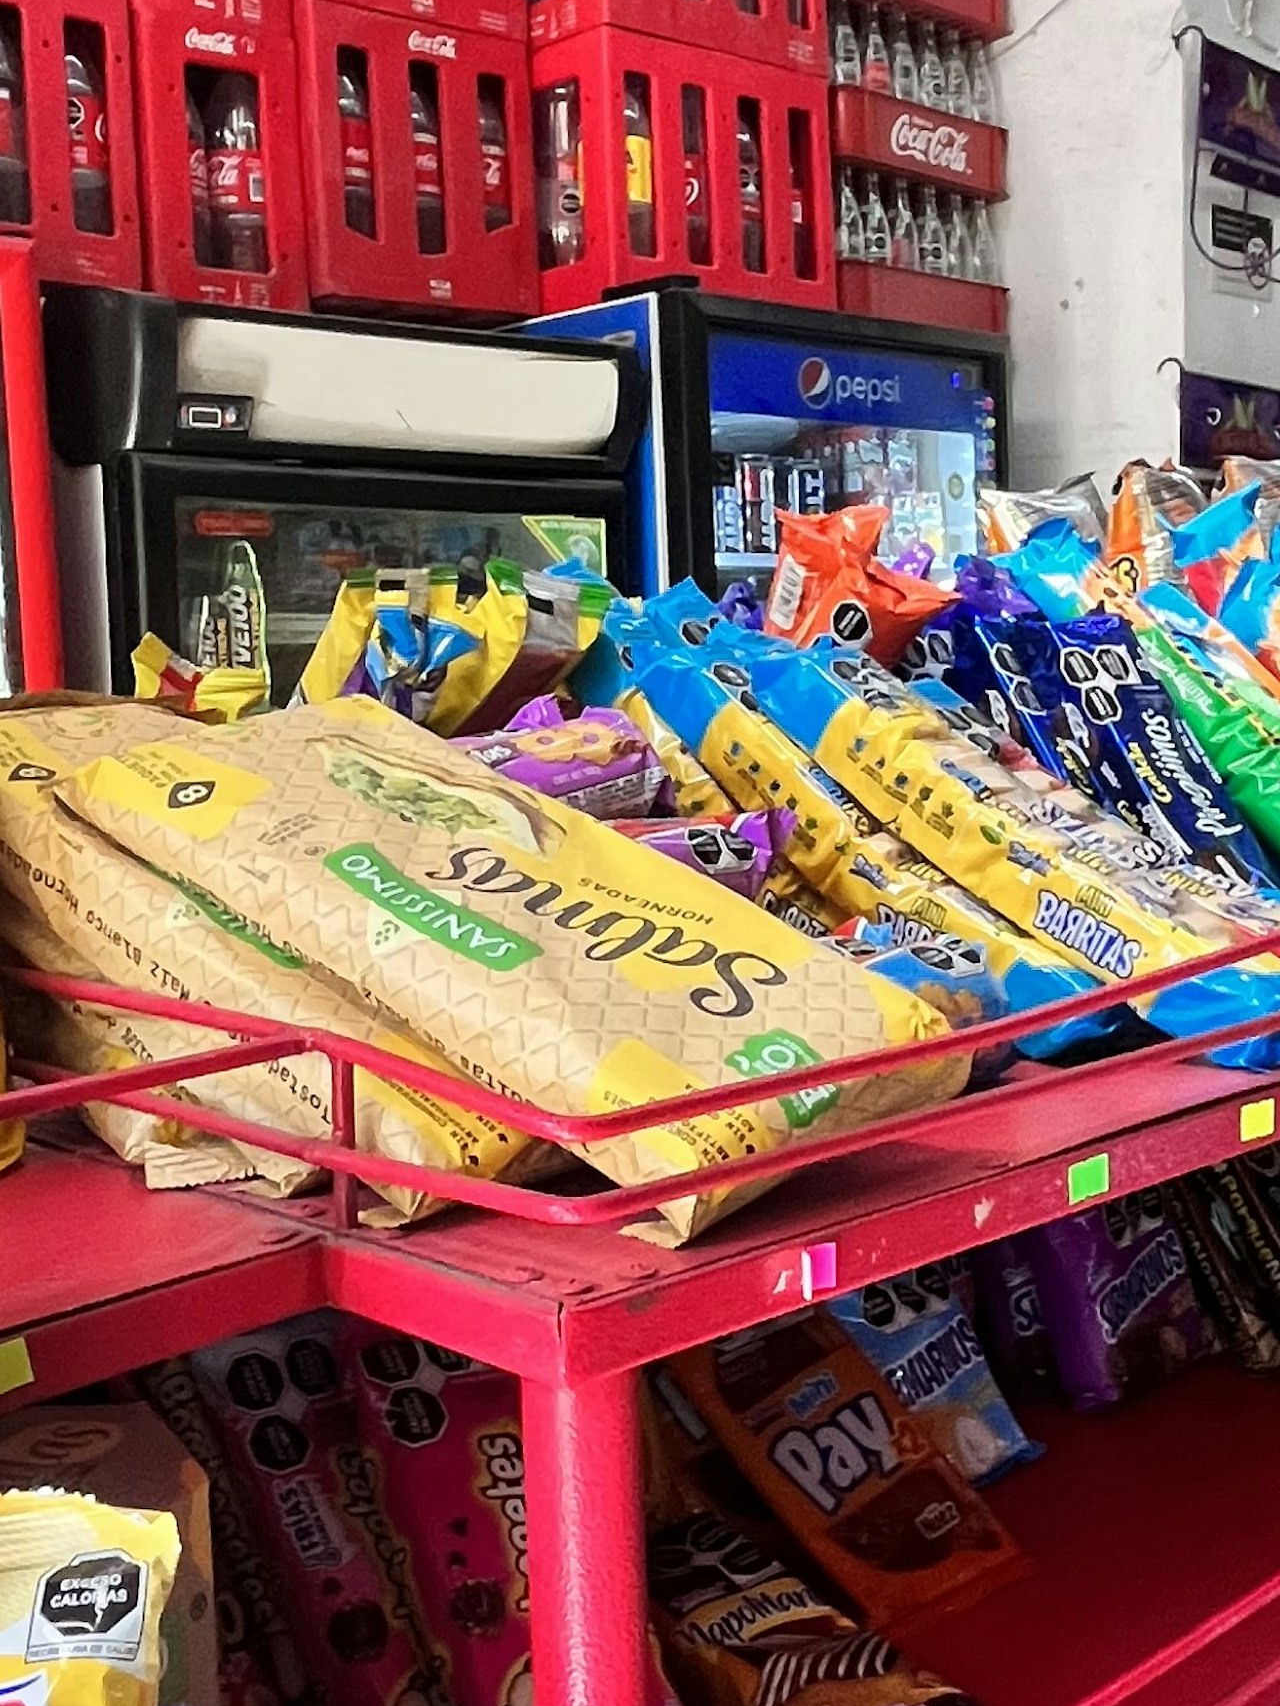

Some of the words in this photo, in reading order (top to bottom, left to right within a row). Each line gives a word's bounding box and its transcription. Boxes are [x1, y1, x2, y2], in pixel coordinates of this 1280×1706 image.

[834, 373, 902, 408] pepsi
[426, 846, 789, 1021] Salmas
[578, 876, 716, 926] HORNEADAS
[772, 1391, 904, 1515] Pay
